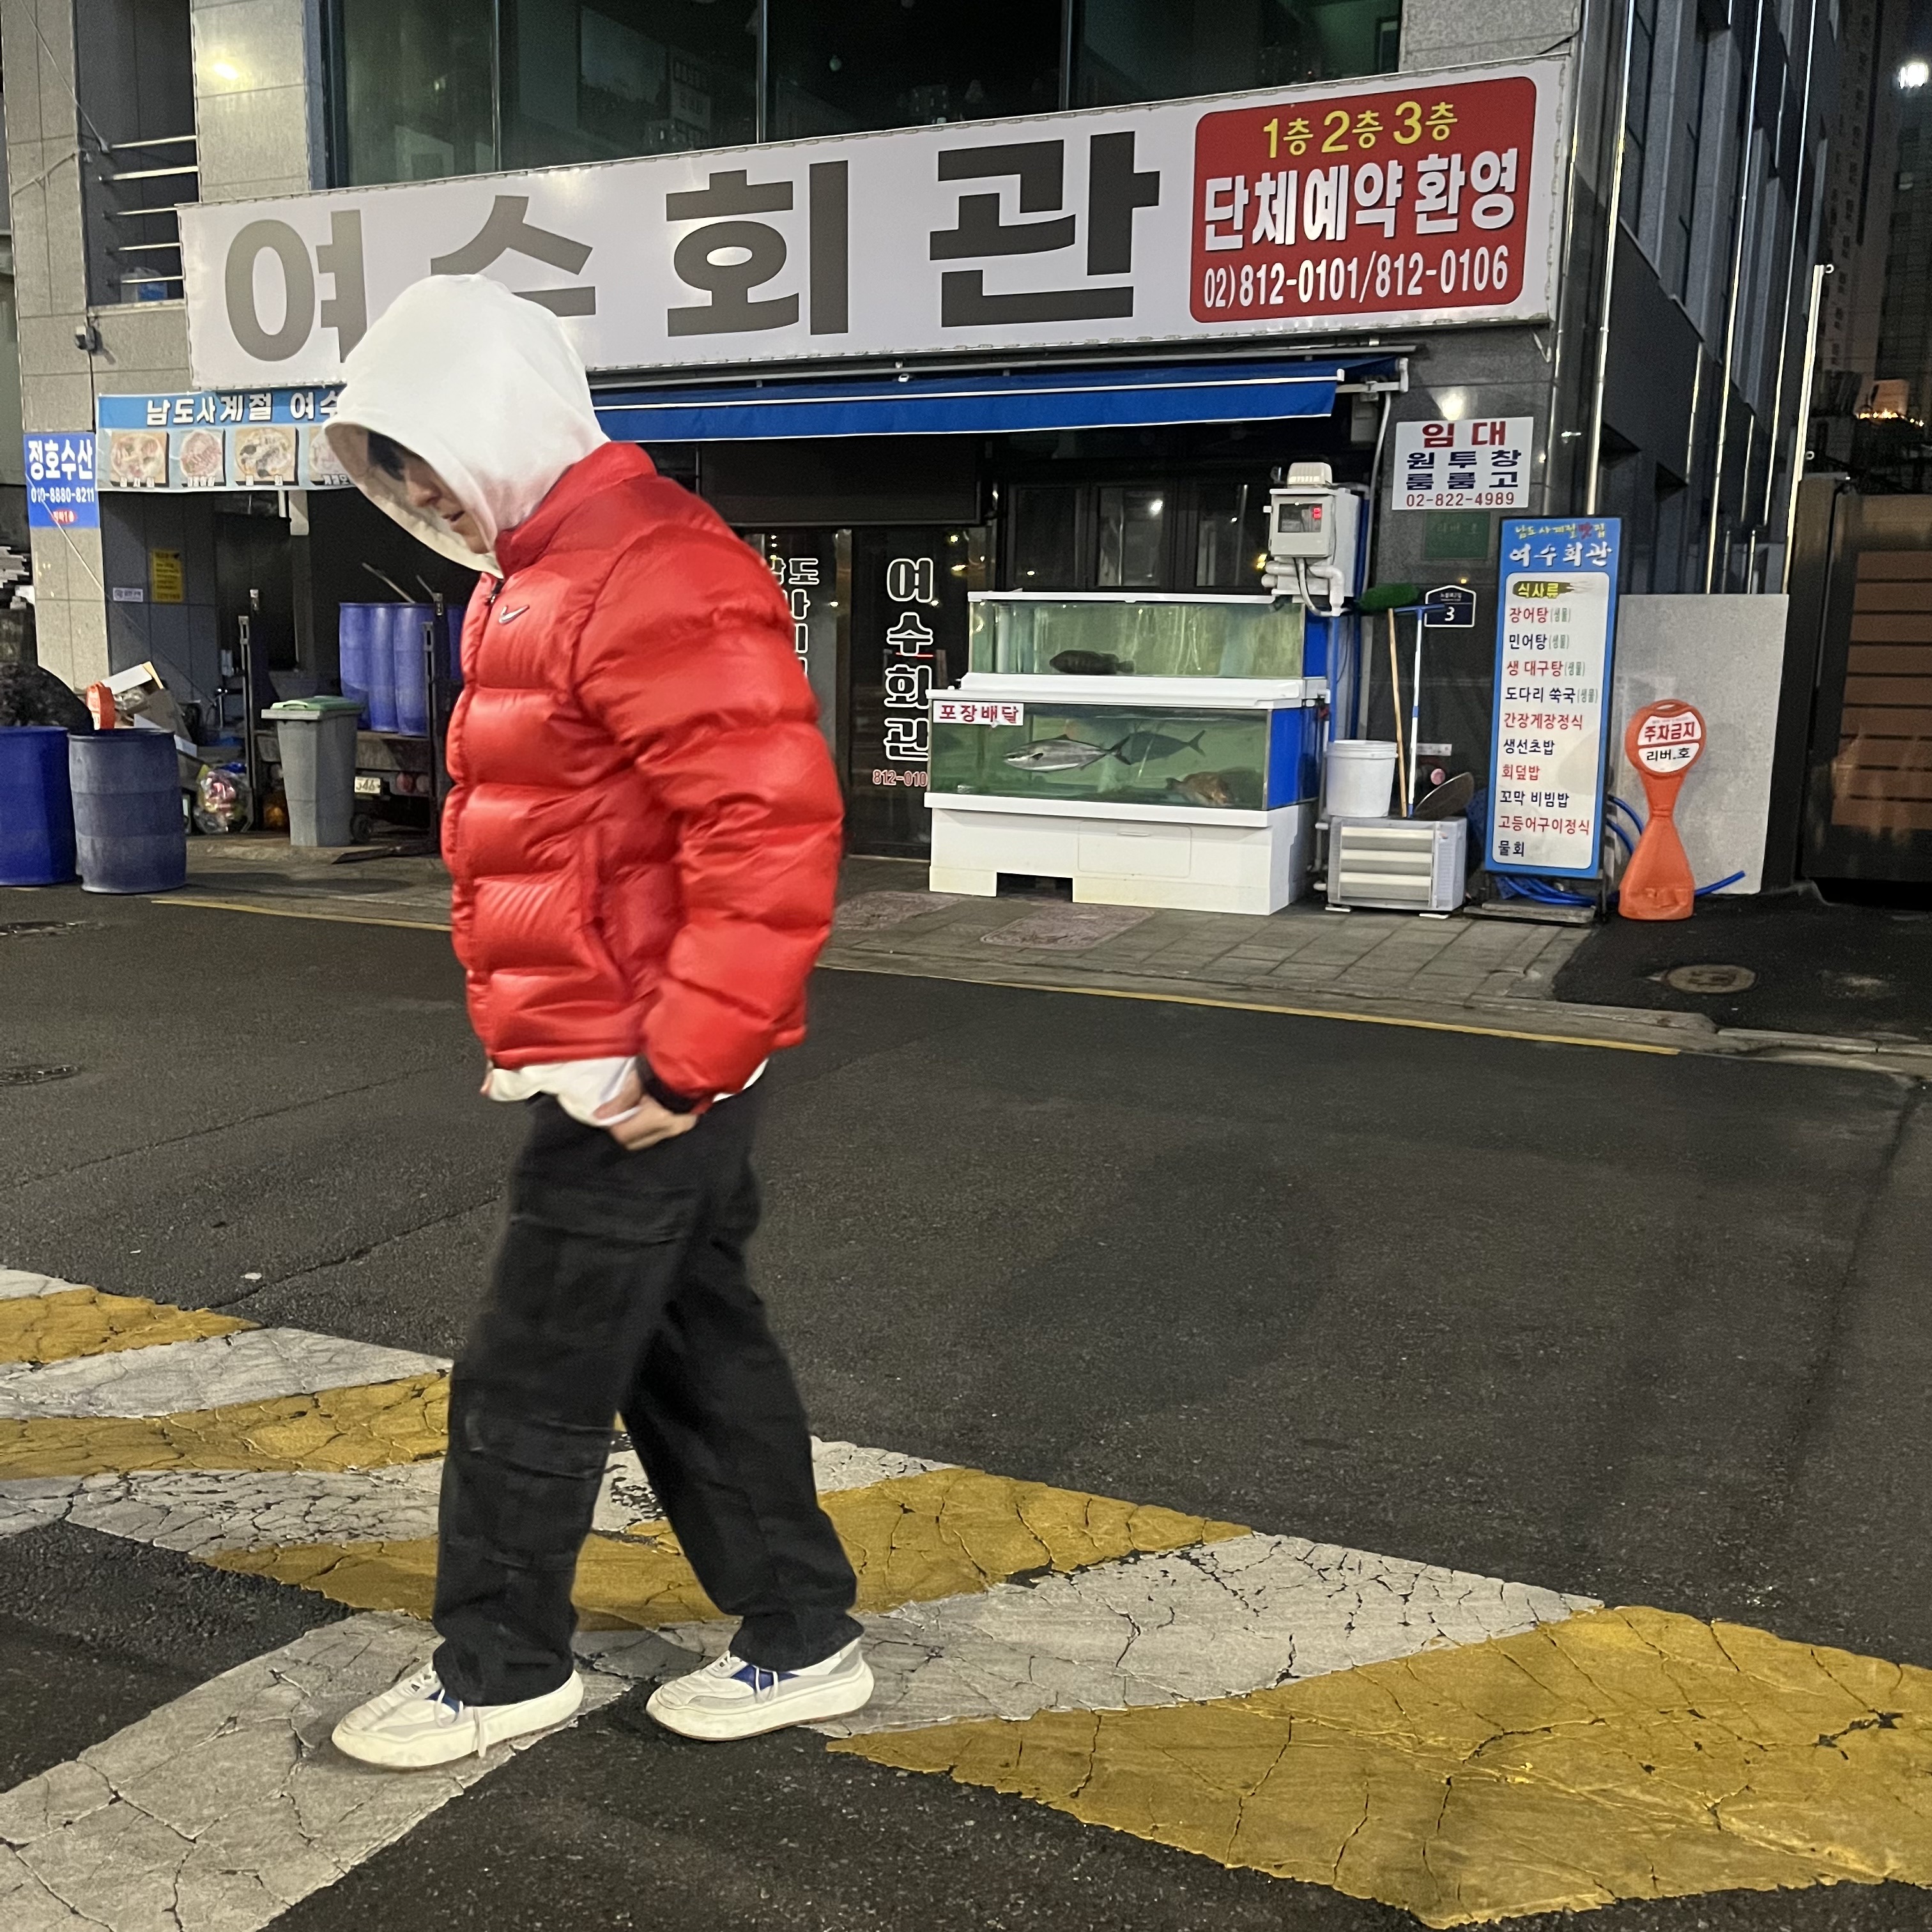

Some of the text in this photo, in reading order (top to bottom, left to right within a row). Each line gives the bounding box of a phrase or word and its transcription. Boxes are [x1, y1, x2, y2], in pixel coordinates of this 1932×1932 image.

[1263, 101, 1458, 158] 1층 2층 3층
[1205, 148, 1518, 251] 단체예약 환영
[1204, 245, 1509, 309] 02)812-0101/812-0106
[146, 392, 272, 426] 남도사계절
[1422, 420, 1506, 448] 임대
[28, 439, 93, 480] 정호수산
[1406, 491, 1514, 507] 02-822-4989
[1510, 541, 1613, 567] 여수회관
[1518, 582, 1559, 599] 식사류
[1445, 606, 1455, 621] 3
[1505, 687, 1544, 703] 도다리
[939, 705, 1019, 724] 포장배달
[1504, 712, 1583, 730] 간장게장정식
[1503, 739, 1555, 755] 생선초밥
[1502, 763, 1540, 781] 회덮밥
[1500, 790, 1570, 808] 꼬막 비빔밥
[1498, 815, 1590, 836] 고등어구이정식
